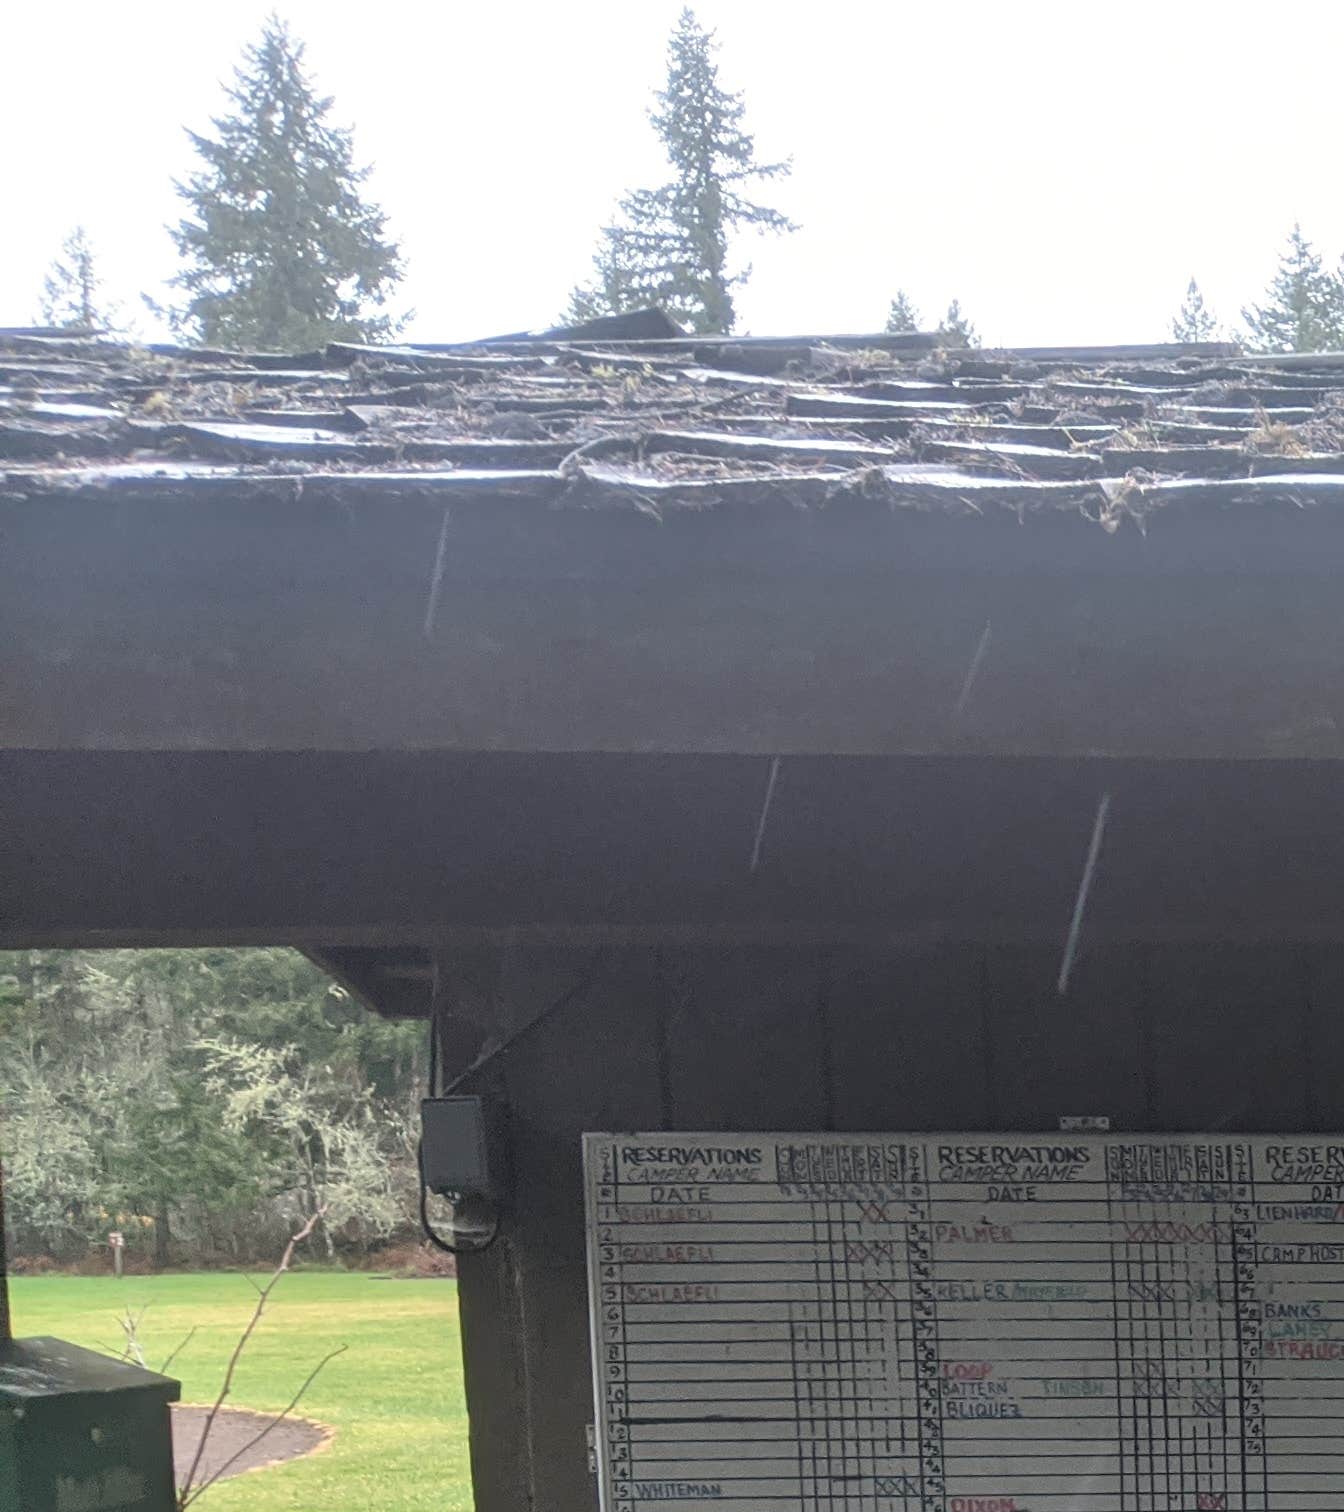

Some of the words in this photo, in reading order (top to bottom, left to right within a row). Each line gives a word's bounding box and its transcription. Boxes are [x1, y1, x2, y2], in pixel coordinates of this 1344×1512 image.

[623, 1146, 762, 1164] RESERVATIONS
[939, 1145, 1090, 1164] RESERVATIONS
[939, 1165, 1020, 1181] CAMPER
[1026, 1165, 1083, 1181] NAME
[1272, 1165, 1341, 1182] CAMPER
[651, 1186, 710, 1202] DATE
[989, 1185, 1036, 1200] DATE
[936, 1225, 1014, 1243] PALMER
[1265, 1303, 1321, 1318] BANKS
[636, 1483, 721, 1498] WHITEMAN
